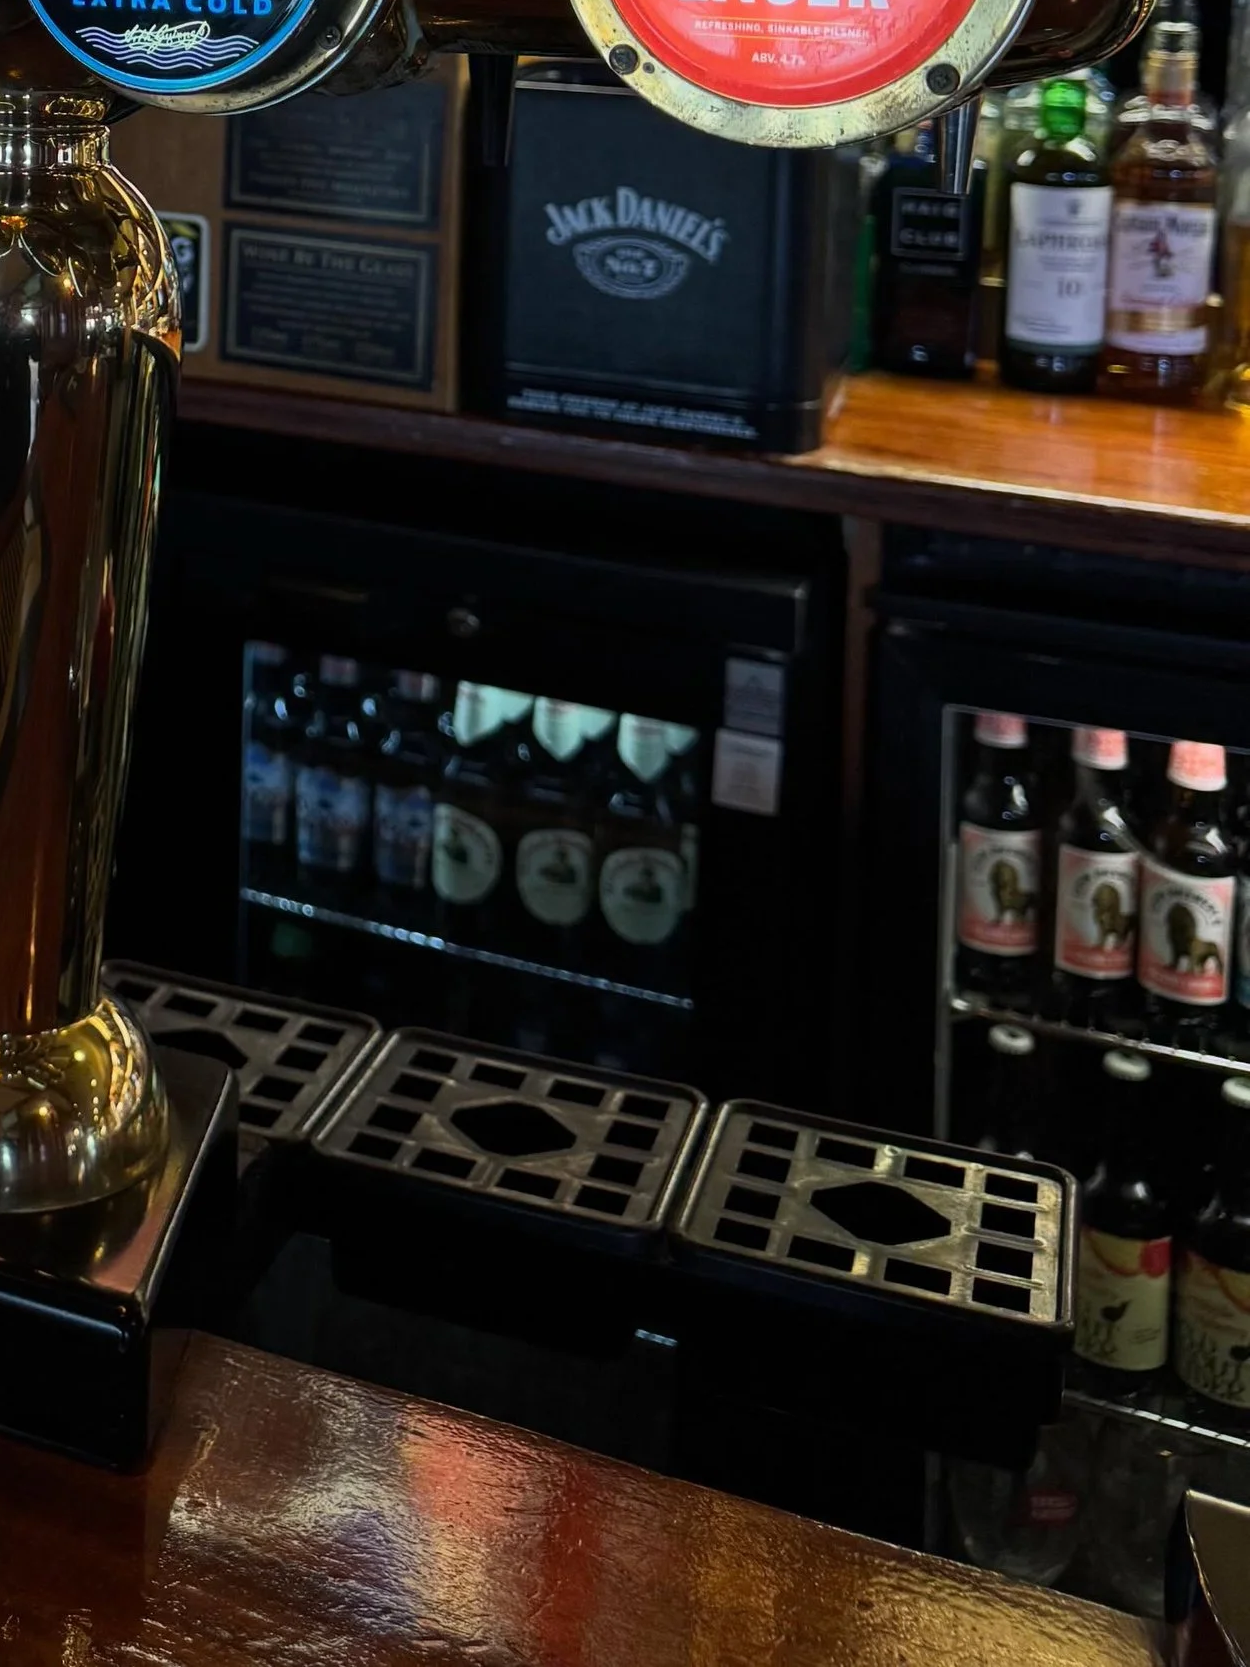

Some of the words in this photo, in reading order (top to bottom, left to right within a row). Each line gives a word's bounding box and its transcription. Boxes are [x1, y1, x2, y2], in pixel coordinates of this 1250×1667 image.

[694, 19, 764, 34] REFRESHING,
[767, 22, 821, 36] SINKABLE
[823, 26, 871, 39] PILSNER
[751, 52, 778, 65] ABV.
[543, 194, 616, 246] JACK
[615, 184, 732, 267] DANIEL'S
